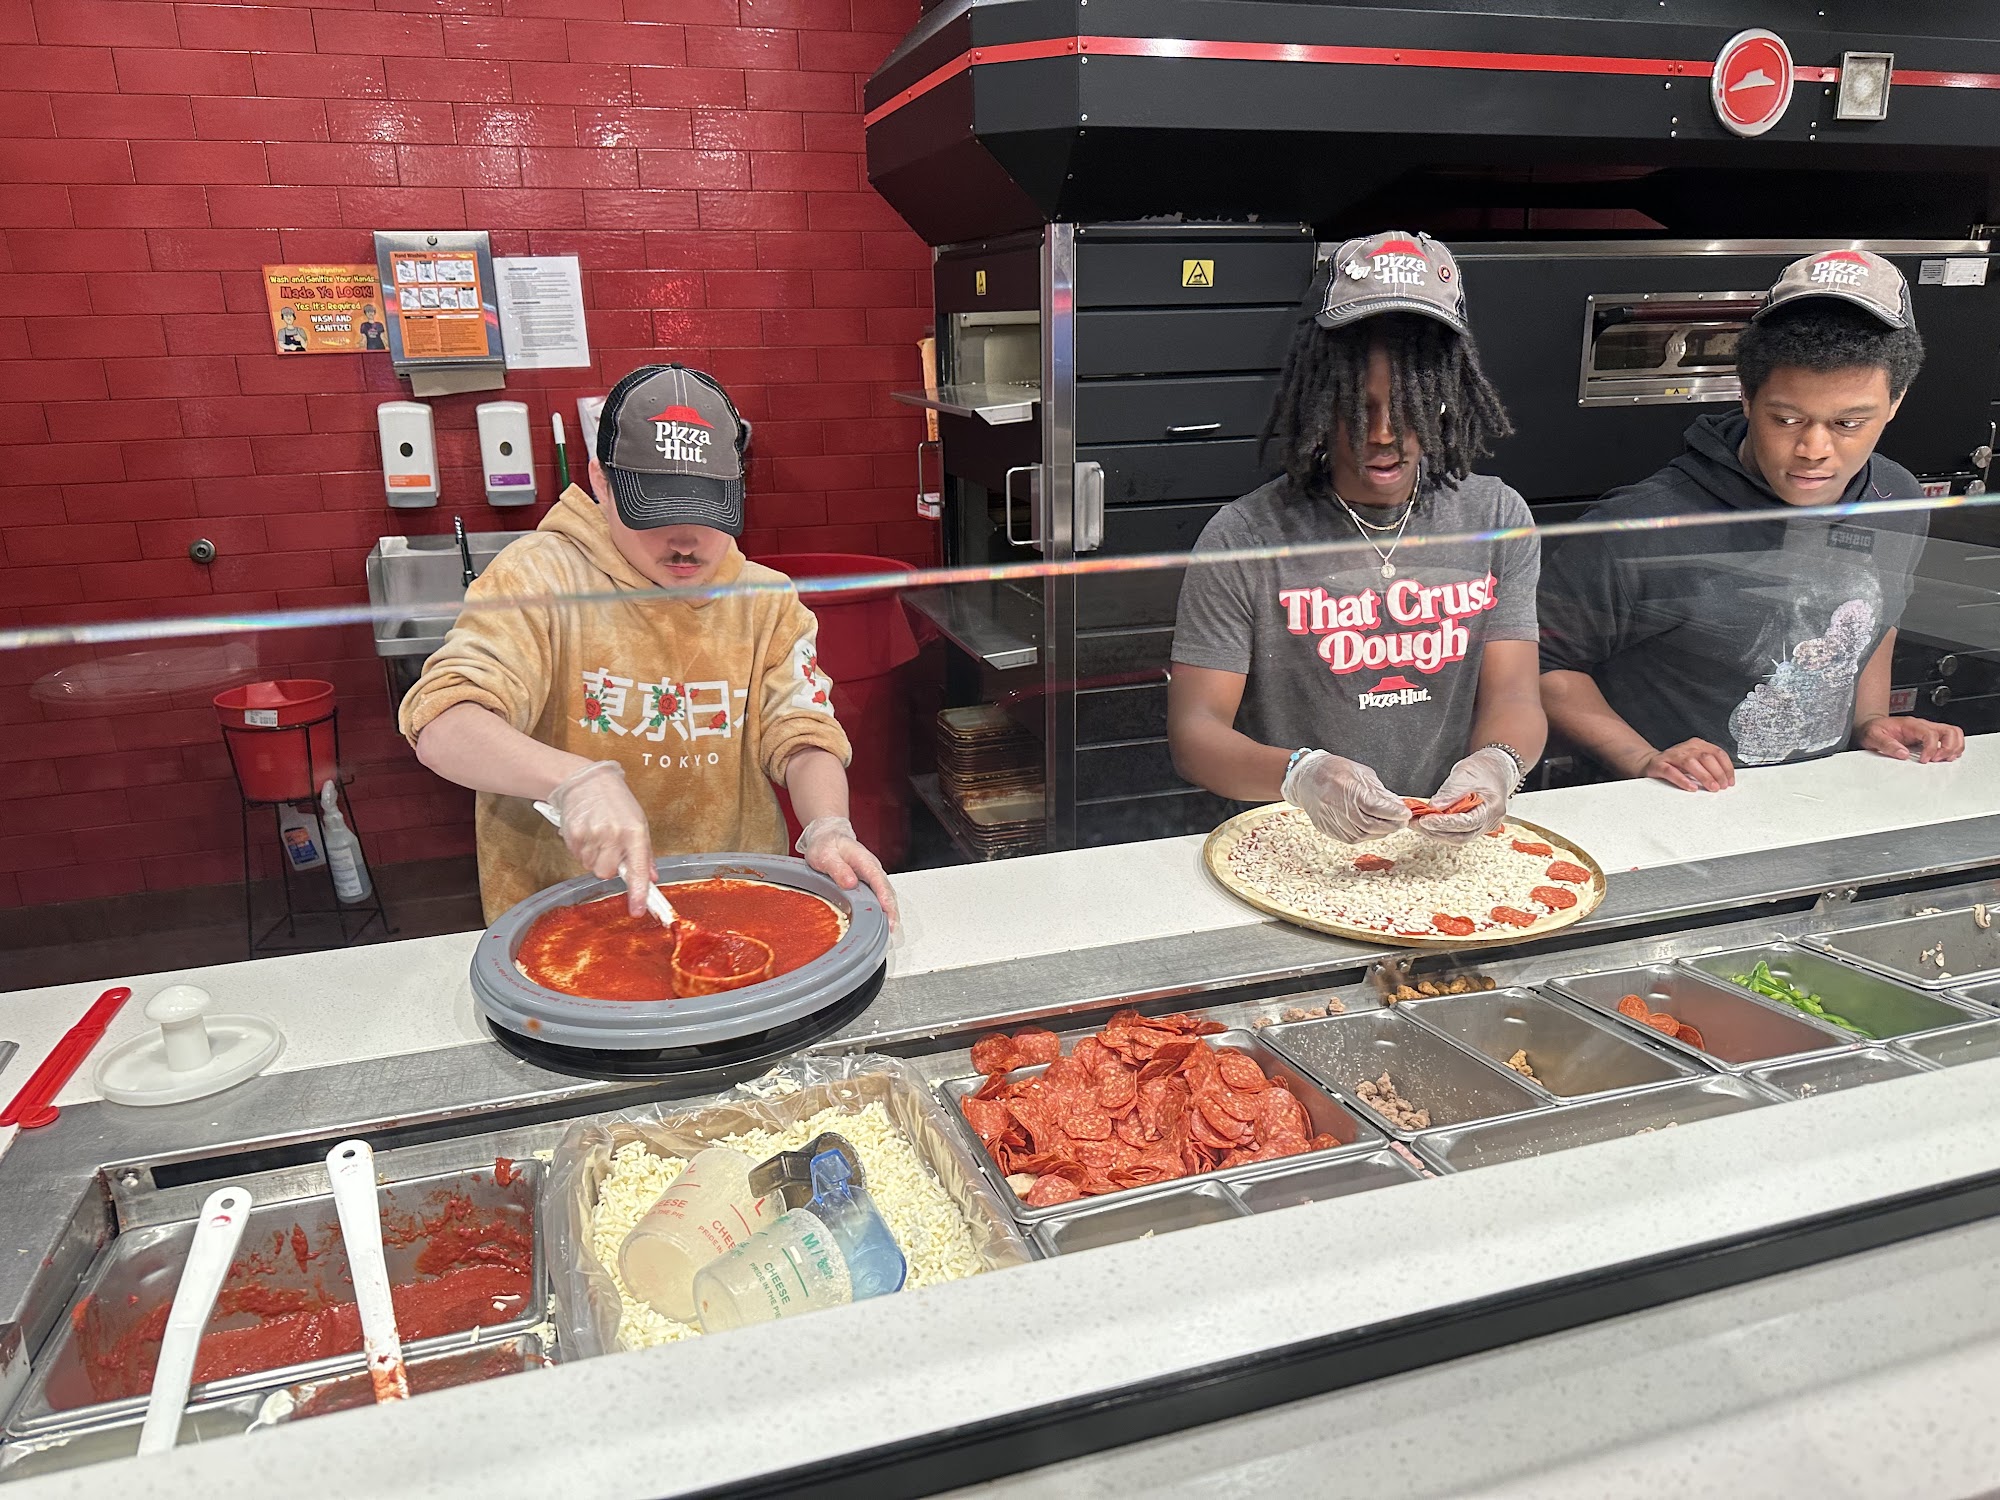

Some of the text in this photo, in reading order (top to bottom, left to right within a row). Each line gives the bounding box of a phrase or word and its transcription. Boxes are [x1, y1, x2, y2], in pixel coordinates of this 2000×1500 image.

[1373, 253, 1428, 273] Pizza
[1811, 260, 1869, 277] Pizza
[269, 274, 289, 284] Wash
[291, 275, 304, 283] and
[306, 274, 334, 284] Sanitize
[336, 275, 352, 283] Your
[280, 286, 374, 298] Made Ya LOOK!
[327, 302, 361, 312] Required
[310, 314, 352, 324] WASH AND
[314, 324, 352, 332] SANITIZE!
[655, 421, 712, 446] Pizza
[1279, 570, 1498, 634] That Crust
[1317, 618, 1469, 674] Dough
[1358, 691, 1400, 710] Pizza
[642, 752, 719, 769] TOKYO
[698, 1225, 723, 1254] PRIDE IN
[712, 1220, 736, 1250] CHEE
[801, 1232, 820, 1250] M
[749, 1262, 782, 1319] PRIDE IN THE PIE
[764, 1262, 791, 1305] CHEESE
